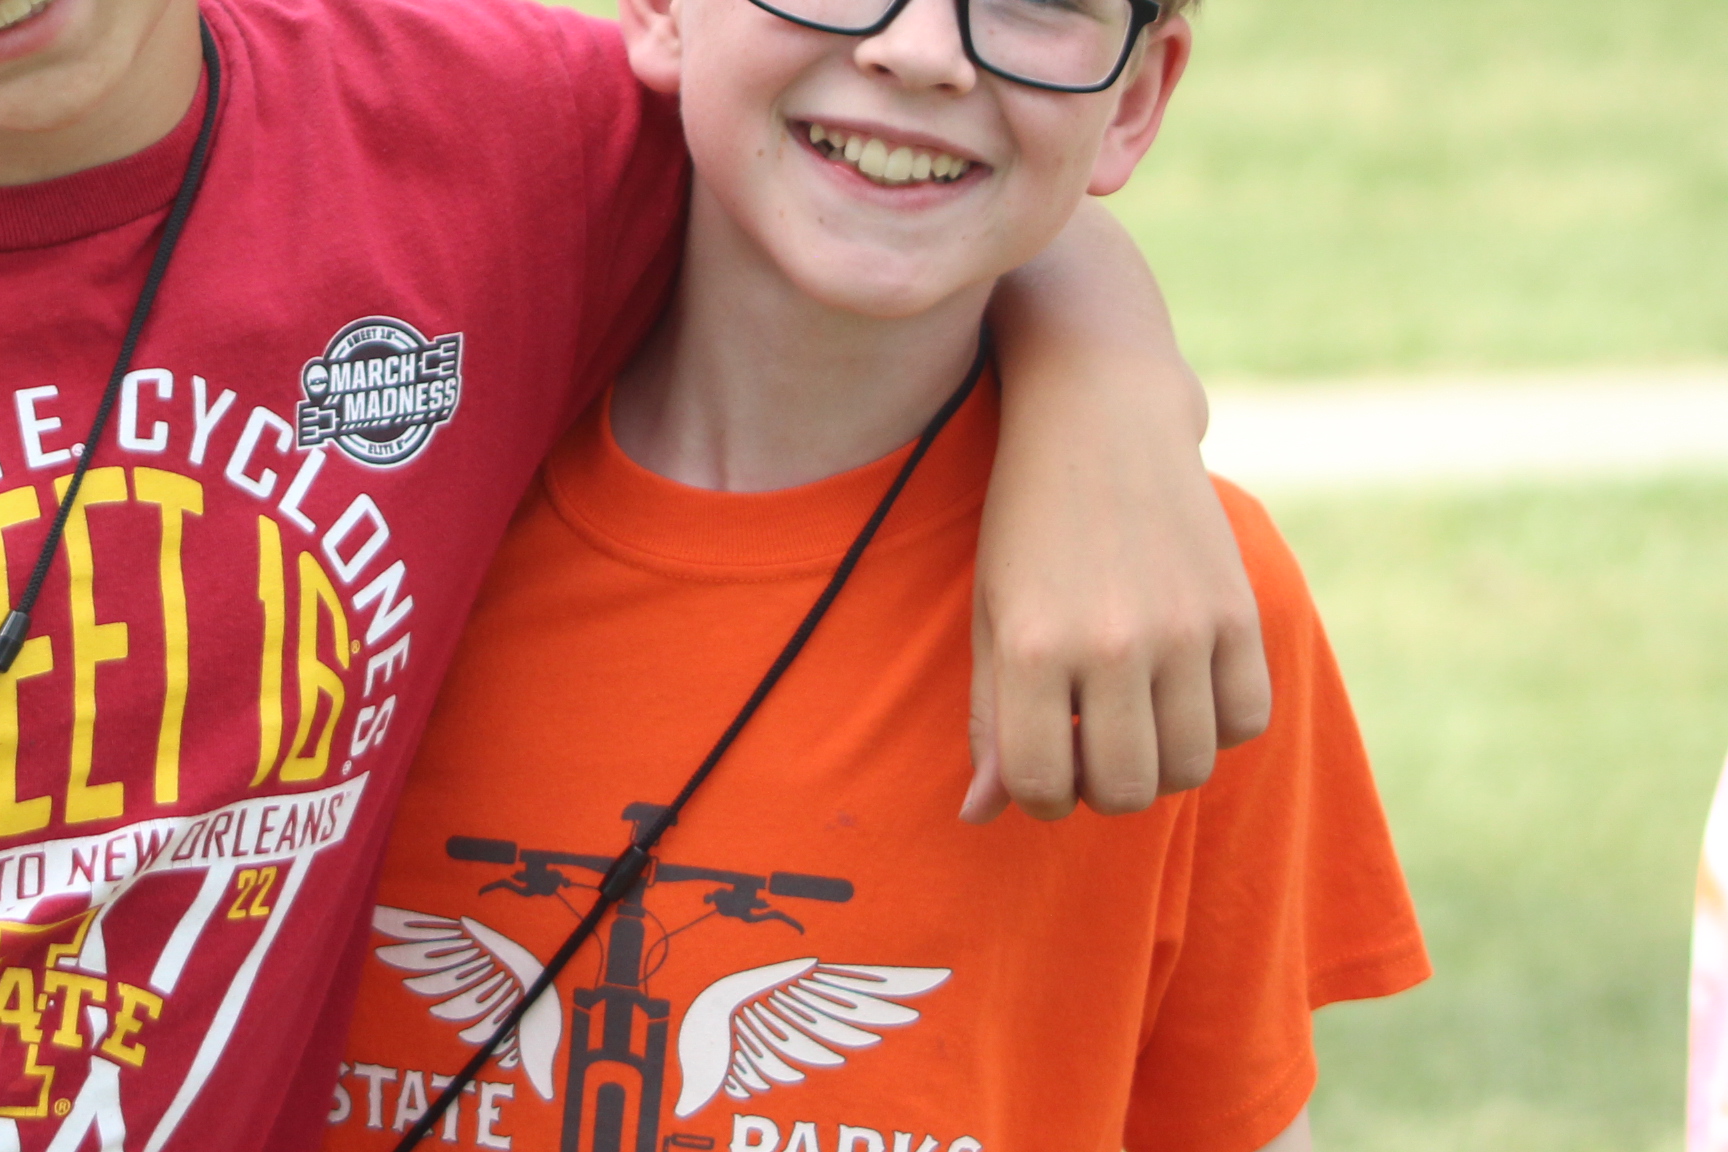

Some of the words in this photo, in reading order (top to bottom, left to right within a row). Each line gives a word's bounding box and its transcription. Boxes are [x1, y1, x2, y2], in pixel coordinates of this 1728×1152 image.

[330, 352, 416, 393] MARCH
[343, 377, 457, 422] MADNESS
[119, 368, 414, 757] CYCLONES
[248, 514, 350, 788] 16
[68, 828, 175, 883] NEW
[172, 791, 343, 861] ORLEANS
[226, 865, 278, 920] 22
